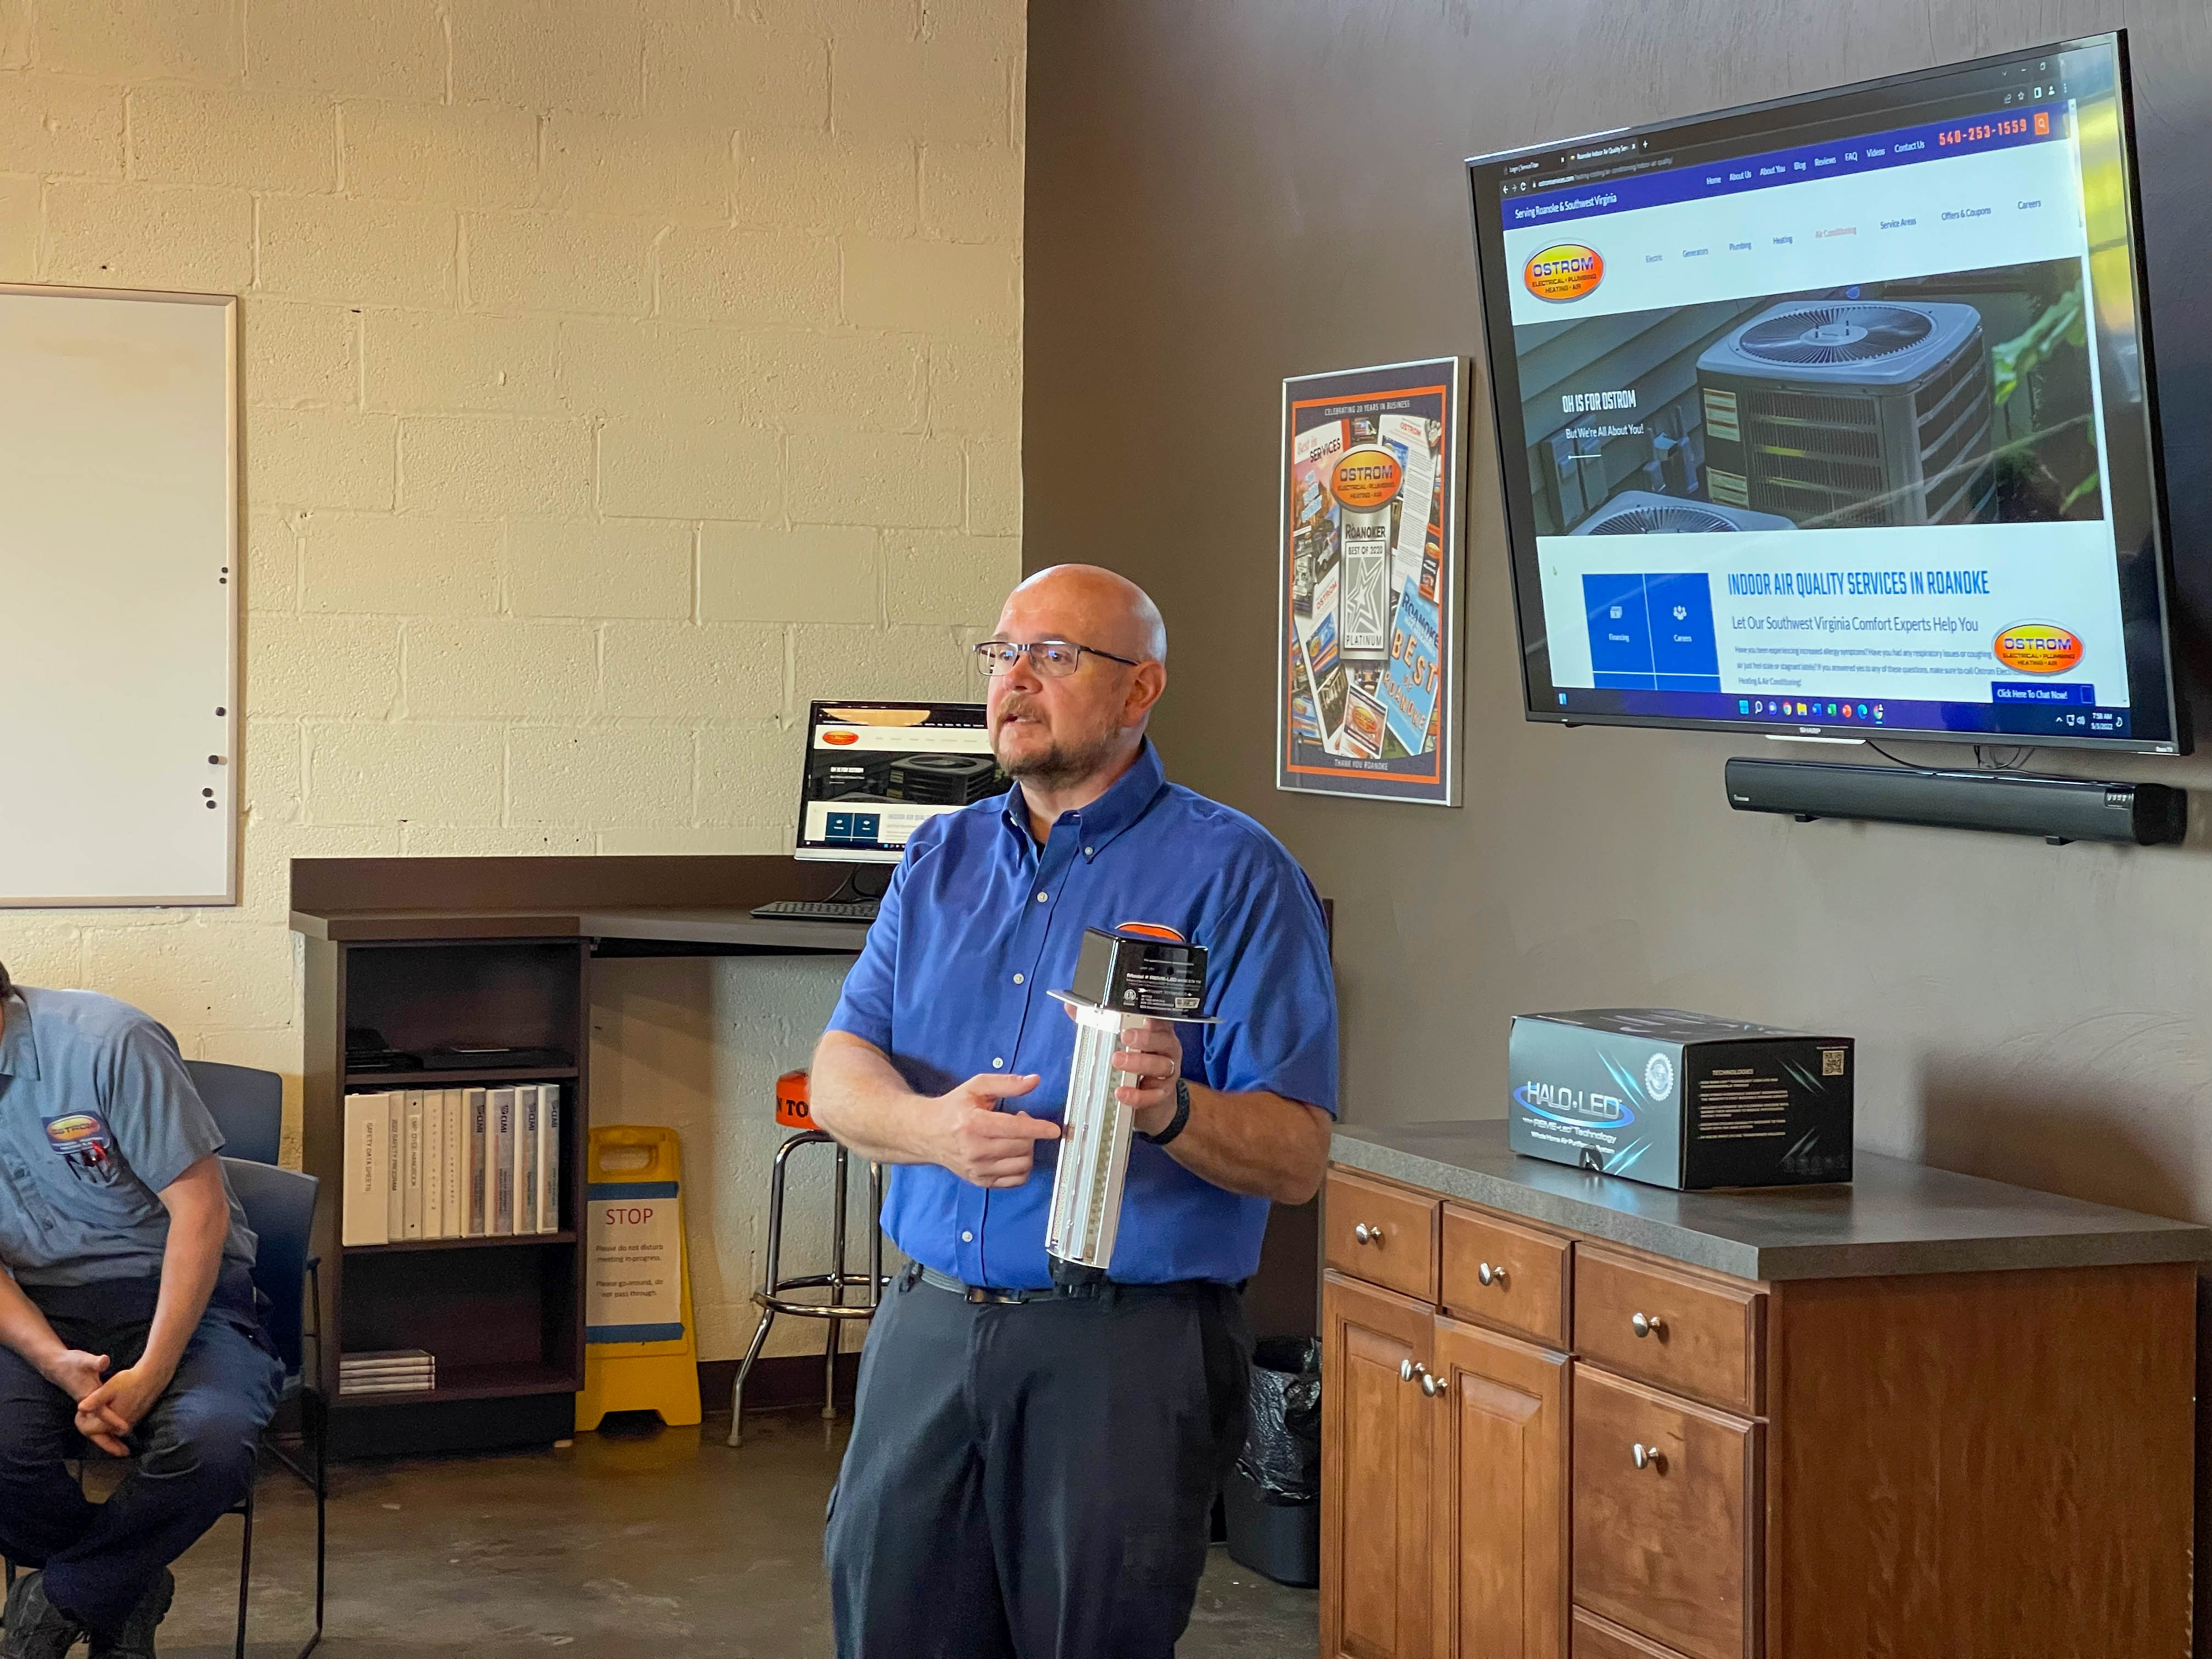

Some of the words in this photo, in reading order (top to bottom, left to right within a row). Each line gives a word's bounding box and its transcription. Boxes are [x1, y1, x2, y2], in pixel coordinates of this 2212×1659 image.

[1939, 119, 2027, 145] 540-253-1559
[1866, 148, 1886, 157] Videos
[1894, 142, 1917, 153] Contact
[1917, 140, 1925, 149] Us
[1814, 157, 1836, 167] Reviews
[1845, 151, 1858, 162] FAQ
[1729, 172, 1745, 181] About
[1760, 167, 1774, 176] About
[1515, 207, 1535, 219] Serving
[1536, 203, 1559, 215] Roanoke
[1559, 202, 1564, 212] &
[1564, 197, 1595, 211] Southwest
[1595, 193, 1617, 206] Virginia
[2018, 200, 2041, 210] Careers
[1941, 211, 1960, 221] Offers
[1960, 210, 1966, 218] &
[1966, 207, 1991, 218] Coupons
[1880, 220, 1900, 230] Service
[1900, 218, 1916, 227] Areas
[1773, 236, 1793, 245] Heating
[1683, 248, 1708, 258] Generators
[1533, 257, 1593, 277] OSTROM
[1532, 278, 1564, 287] ELECTRICAL
[1545, 285, 1568, 294] HEATING
[1363, 403, 1379, 411] YEARS
[1575, 394, 1584, 412] IS
[1584, 392, 1601, 411] FOR
[1602, 390, 1637, 410] OSTROM
[1566, 427, 1577, 439] But
[1578, 426, 1597, 438] We're
[1598, 426, 1607, 437] All
[1607, 425, 1628, 436] About
[1629, 423, 1644, 435] You!
[1310, 438, 1340, 463] SERVICES
[1340, 465, 1392, 482] OSTROM
[1346, 523, 1386, 539] ROANOKER
[1362, 546, 1368, 554] OF
[1728, 573, 1771, 596] INDOOR
[1775, 573, 1795, 596] AIR
[1797, 572, 1844, 598] QUALITY
[1848, 571, 1907, 595] SERVICES
[1910, 571, 1923, 595] IN
[1927, 570, 1990, 595] ROANOKE
[1732, 616, 1747, 630] Let
[1747, 616, 1765, 630] Our
[1765, 615, 1813, 630] Southwest
[1814, 616, 1850, 633] Virginia
[1852, 617, 1892, 630] Comfort
[1894, 617, 1932, 634] Experts
[1933, 617, 1957, 634] Help
[1957, 617, 1978, 631] You
[1346, 635, 1381, 646] PLATINUM
[2004, 638, 2072, 650] OSTROM
[1391, 628, 1438, 693] BEST
[1997, 689, 2012, 698] Click
[2012, 690, 2027, 698] Here
[2027, 690, 2036, 698] To
[2036, 690, 2050, 699] Chat
[2051, 691, 2068, 699] Now!
[1383, 671, 1426, 731] ROANOKE
[1574, 1126, 1617, 1144] Technology
[606, 1208, 653, 1225] STOP
